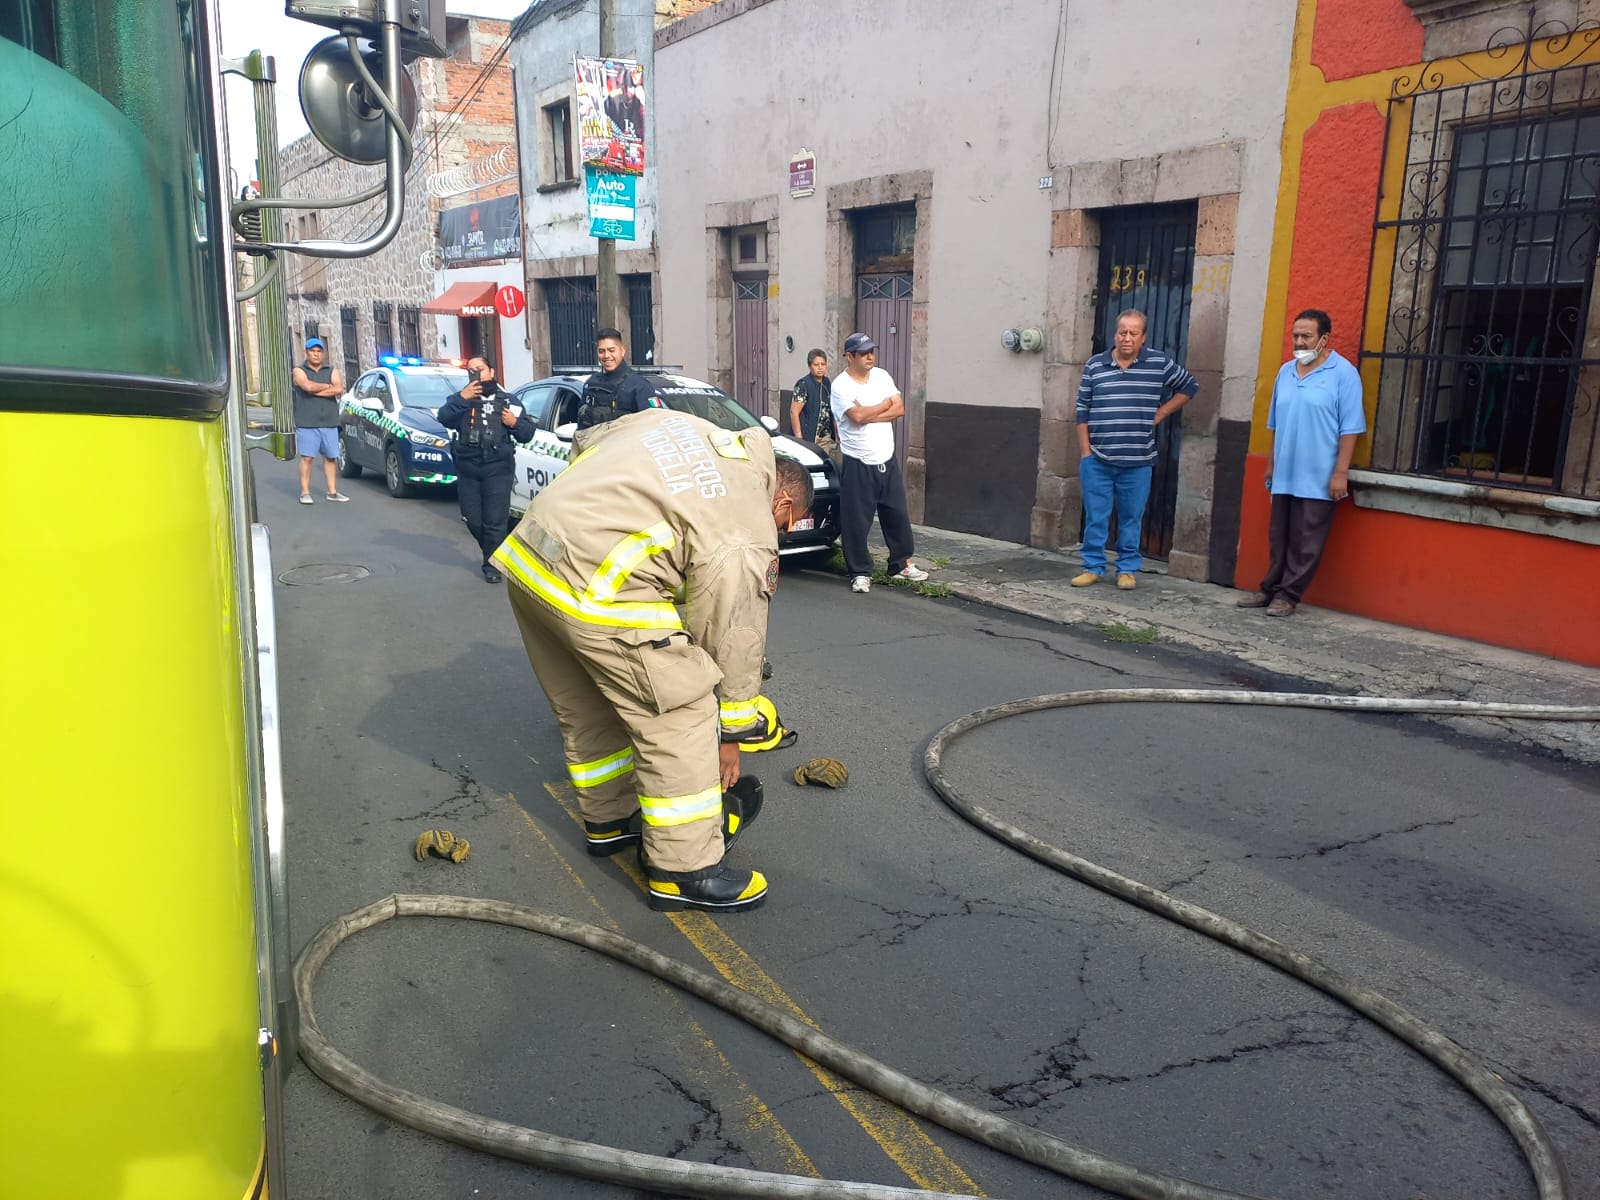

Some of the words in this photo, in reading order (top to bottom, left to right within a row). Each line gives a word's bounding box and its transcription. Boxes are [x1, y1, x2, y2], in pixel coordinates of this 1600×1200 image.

[596, 178, 626, 191] Auto
[1110, 265, 1145, 292] 239
[461, 305, 495, 315] MAKIS
[639, 427, 697, 496] MORELIA
[660, 415, 727, 499] BOMBEROS
